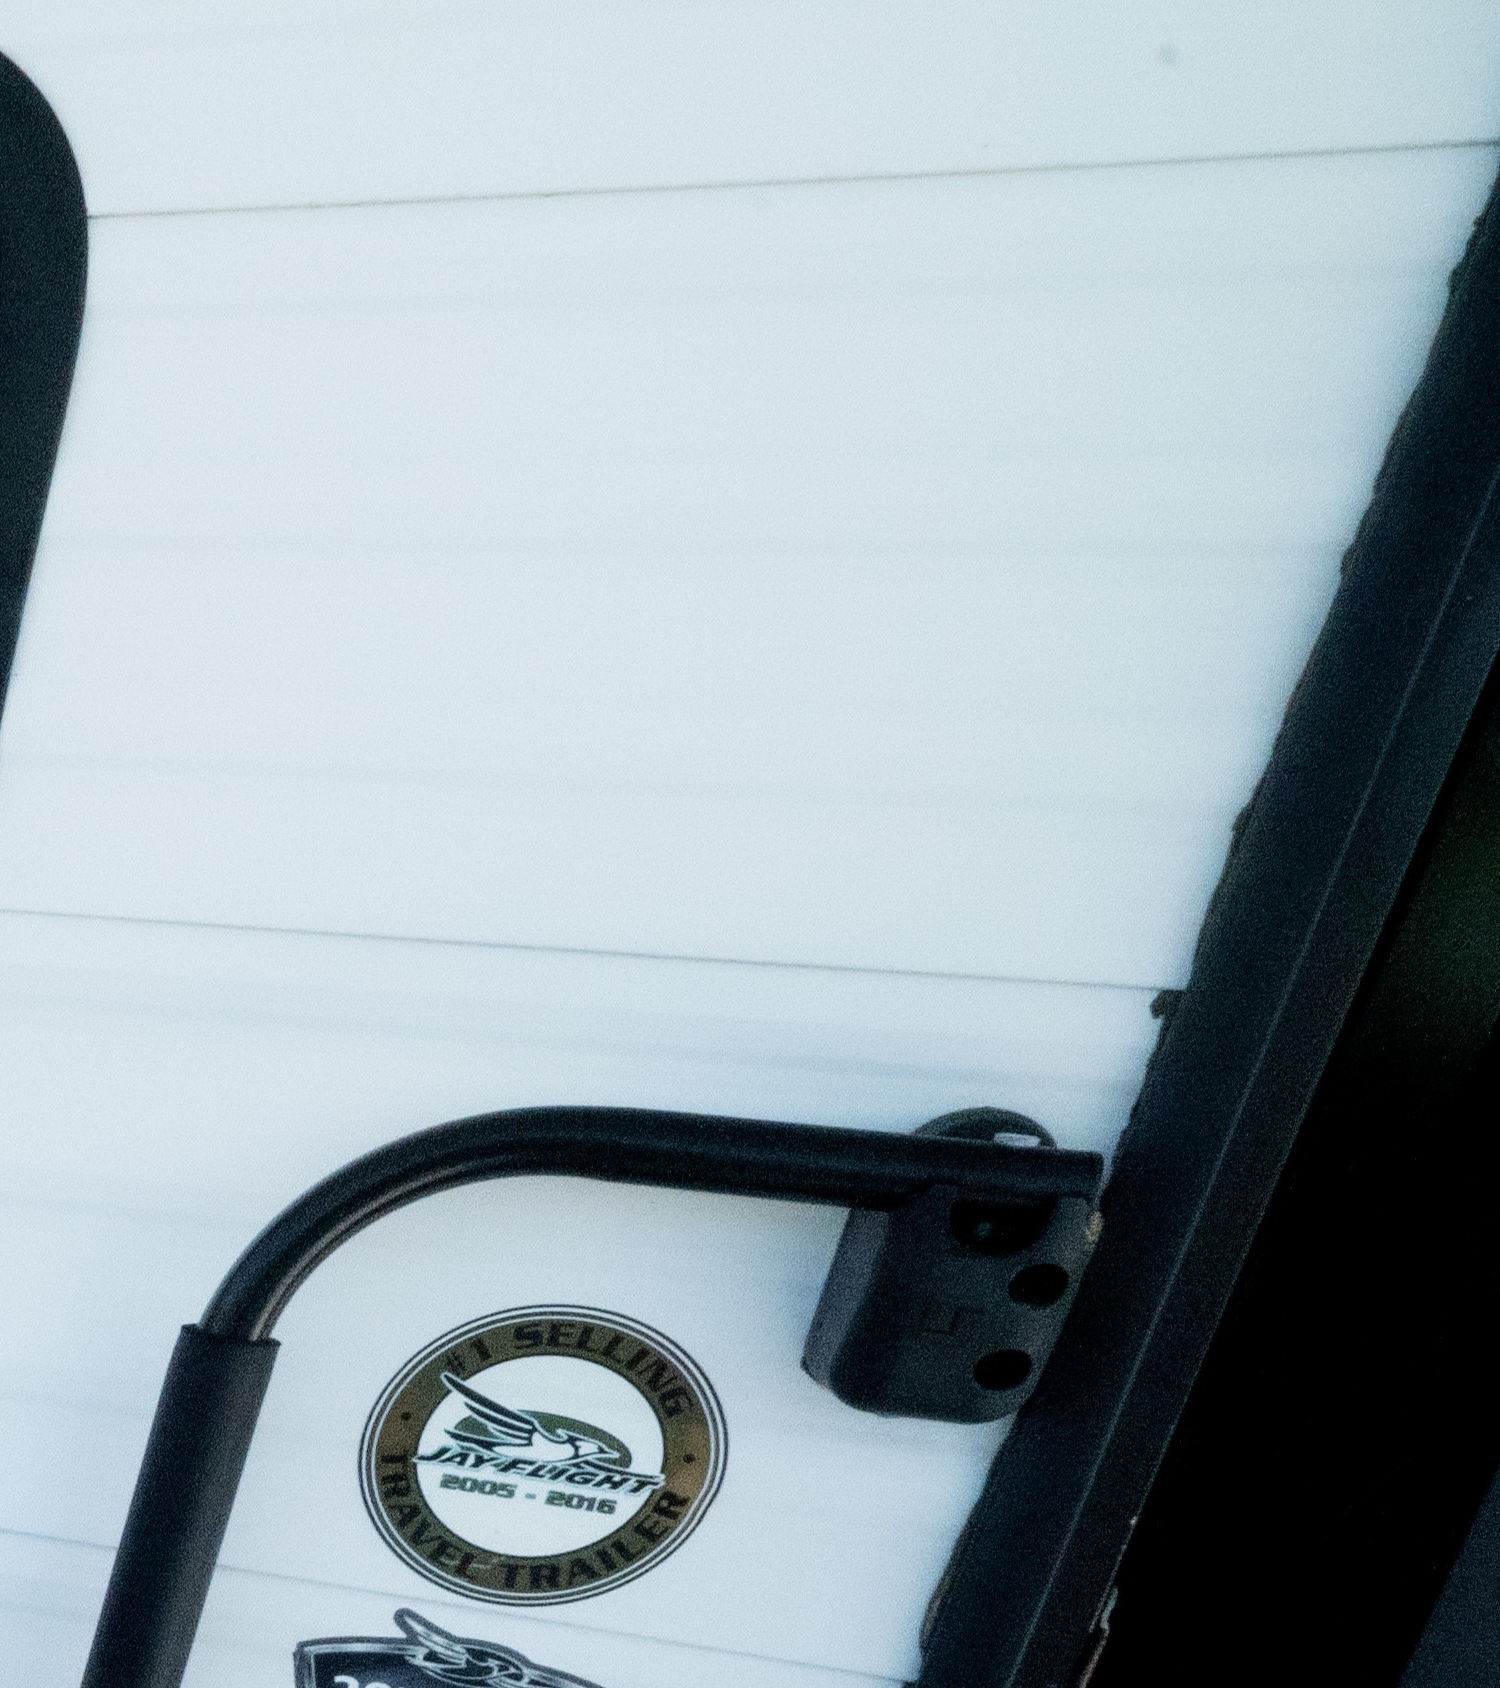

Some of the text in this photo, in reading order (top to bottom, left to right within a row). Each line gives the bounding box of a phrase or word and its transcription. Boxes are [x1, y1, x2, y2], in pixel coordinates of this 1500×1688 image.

[513, 1321, 694, 1418] SELLING
[414, 1446, 664, 1494] JAY FLIGHT
[439, 1472, 518, 1499] 2005
[544, 1489, 618, 1515] 2016
[380, 1453, 692, 1589] TRAVEL TRAILER
